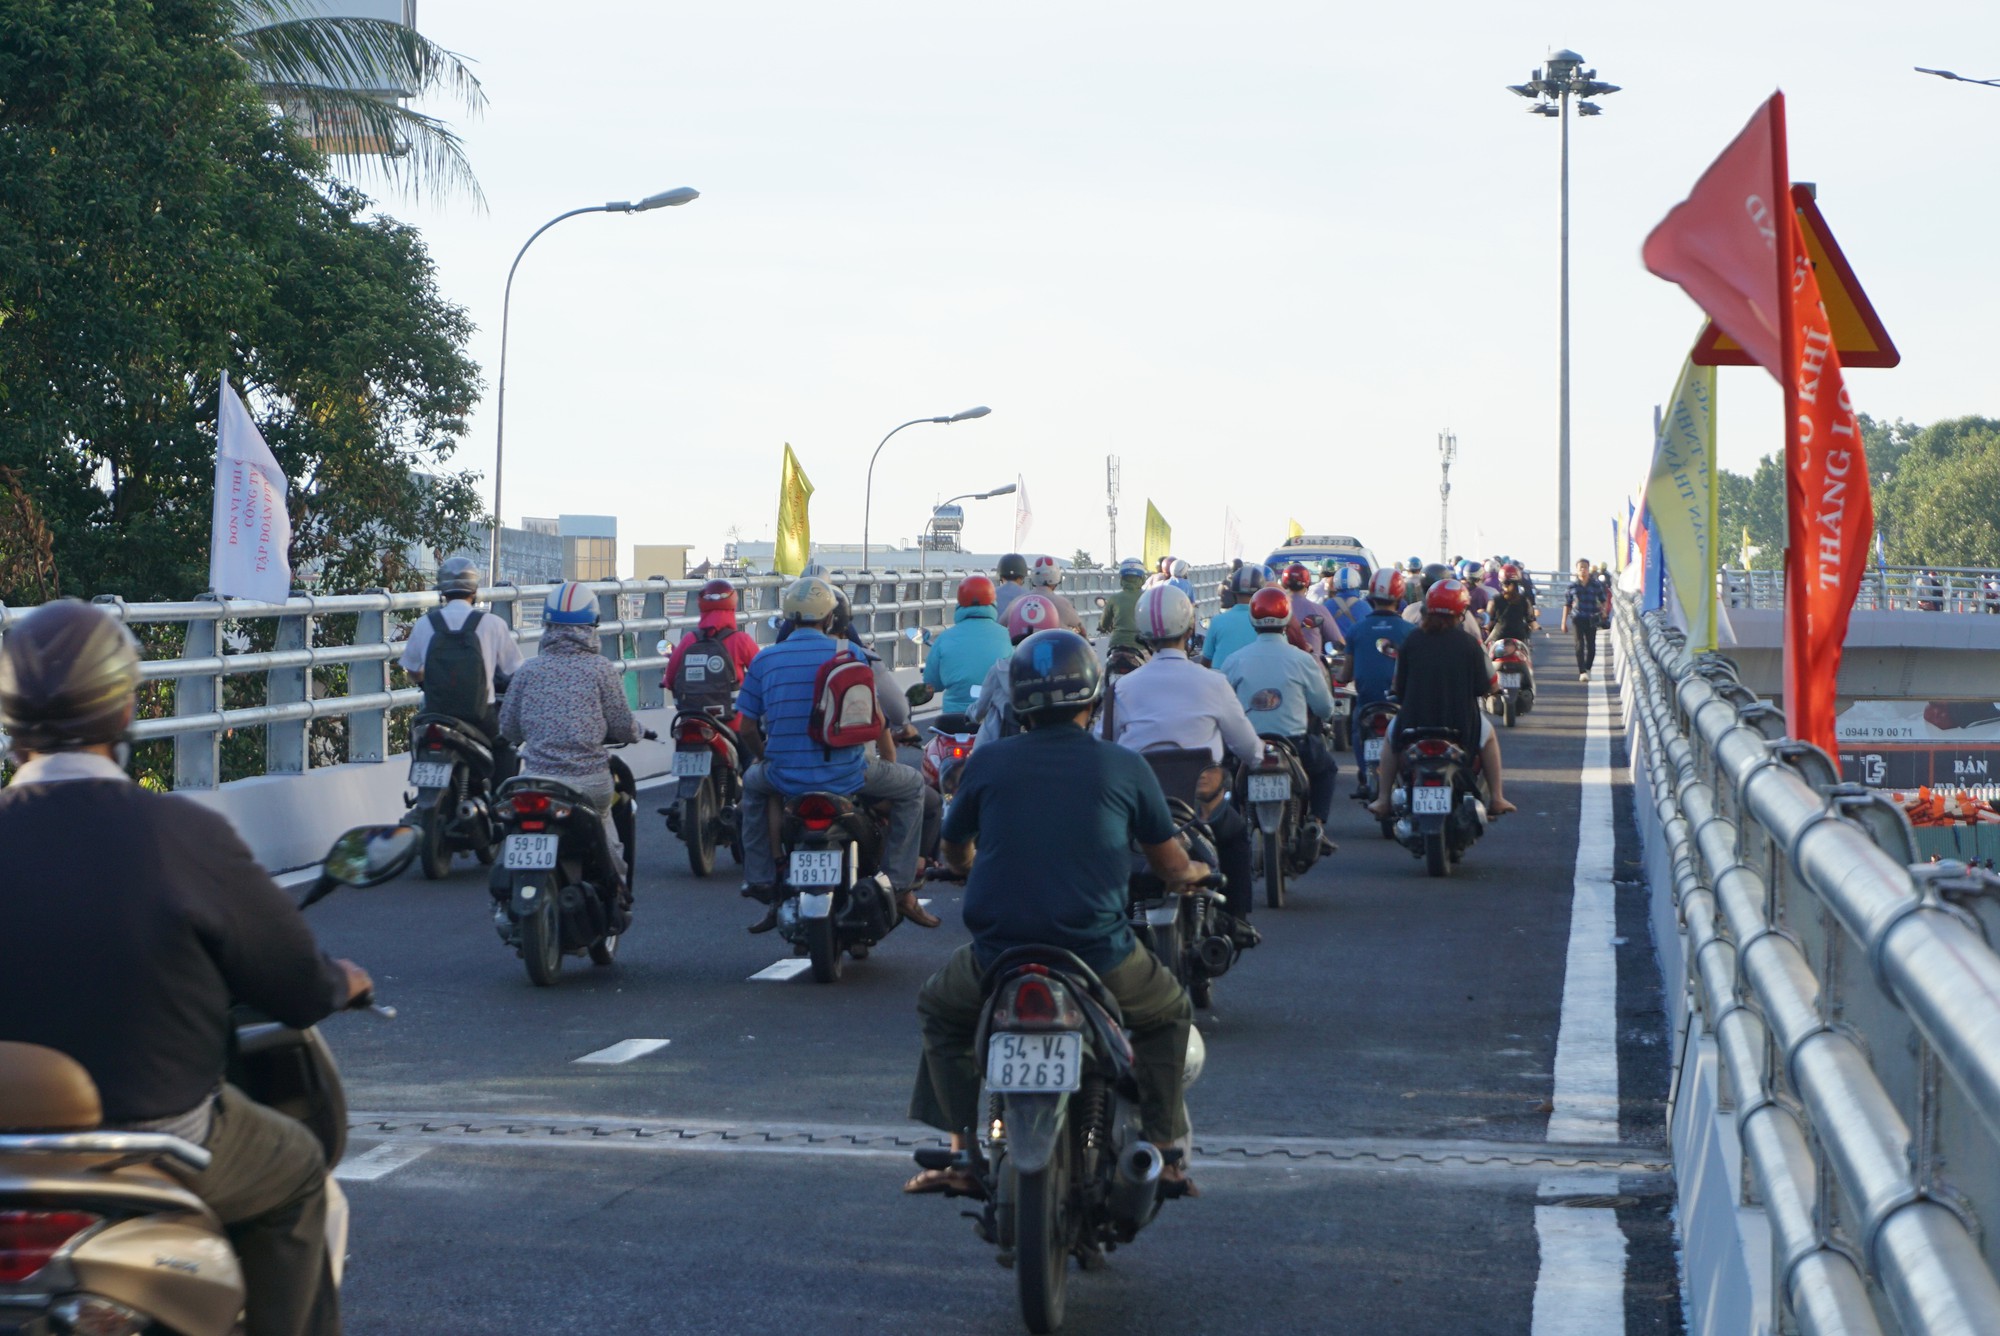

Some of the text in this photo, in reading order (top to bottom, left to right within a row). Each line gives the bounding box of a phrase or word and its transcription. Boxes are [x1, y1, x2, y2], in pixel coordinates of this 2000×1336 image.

[232, 470, 242, 493] THI
[231, 498, 242, 512] VỊ
[243, 489, 257, 528] CÔNG
[228, 515, 239, 545] ĐƠN
[1815, 449, 1851, 591] THĂNG
[254, 546, 269, 573] TẬP
[1845, 728, 1869, 737] 0944
[1872, 728, 1884, 737] 79
[1886, 728, 1898, 737] 00
[1902, 728, 1913, 737] 71
[1418, 788, 1445, 800] 37-L2
[514, 837, 548, 851] 59-D1
[798, 853, 832, 867] 59-E1
[794, 868, 837, 883] 189.17
[1003, 1036, 1066, 1060] 54-V4
[1002, 1063, 1065, 1087] 8263
